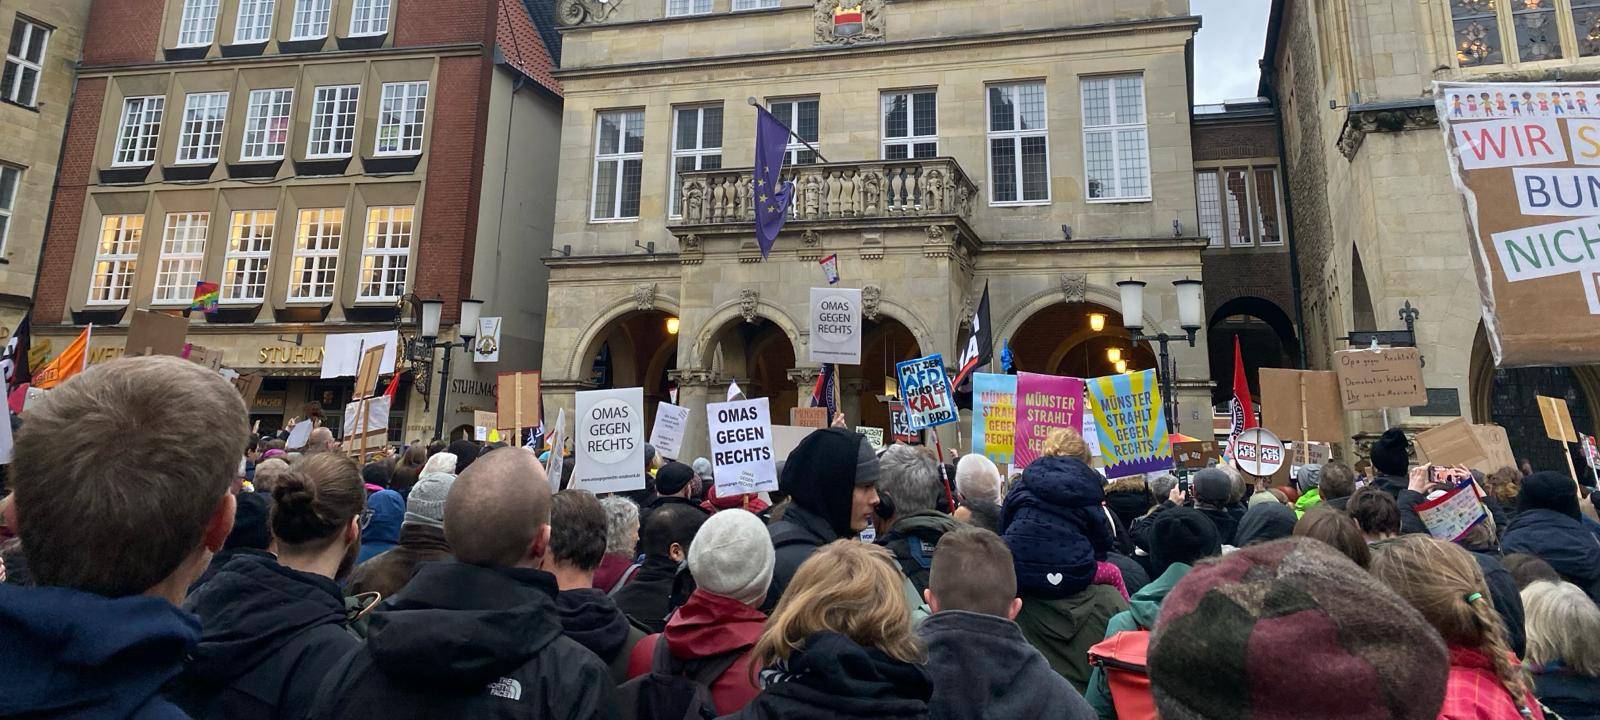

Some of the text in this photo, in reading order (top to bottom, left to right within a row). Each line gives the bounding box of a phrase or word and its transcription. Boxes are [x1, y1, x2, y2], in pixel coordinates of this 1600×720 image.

[1462, 124, 1553, 161] WIR
[821, 301, 849, 311] OMAS
[820, 313, 851, 323] GEGEN
[818, 325, 852, 335] RECHTS
[906, 368, 941, 391] AFD
[934, 381, 945, 393] ES
[908, 391, 945, 413] KALT
[1025, 391, 1076, 411] MÜNSTER
[1101, 391, 1152, 412] MÜNSTER
[592, 406, 629, 421] OMAS
[718, 406, 758, 423] OMAS
[914, 410, 951, 427] IN BRD
[1027, 408, 1073, 425] STRAHLT
[1106, 408, 1152, 427] STRAHLT
[590, 422, 631, 437] GEGEN
[716, 426, 764, 444] GEGEN
[1116, 425, 1150, 442] GEGEN
[588, 437, 634, 453] RECHTS
[1114, 440, 1158, 457] RECHTS.
[1239, 444, 1255, 452] FCK
[1239, 449, 1255, 457] AFD
[715, 446, 771, 466] RECHTS
[1261, 452, 1277, 460] AFD
